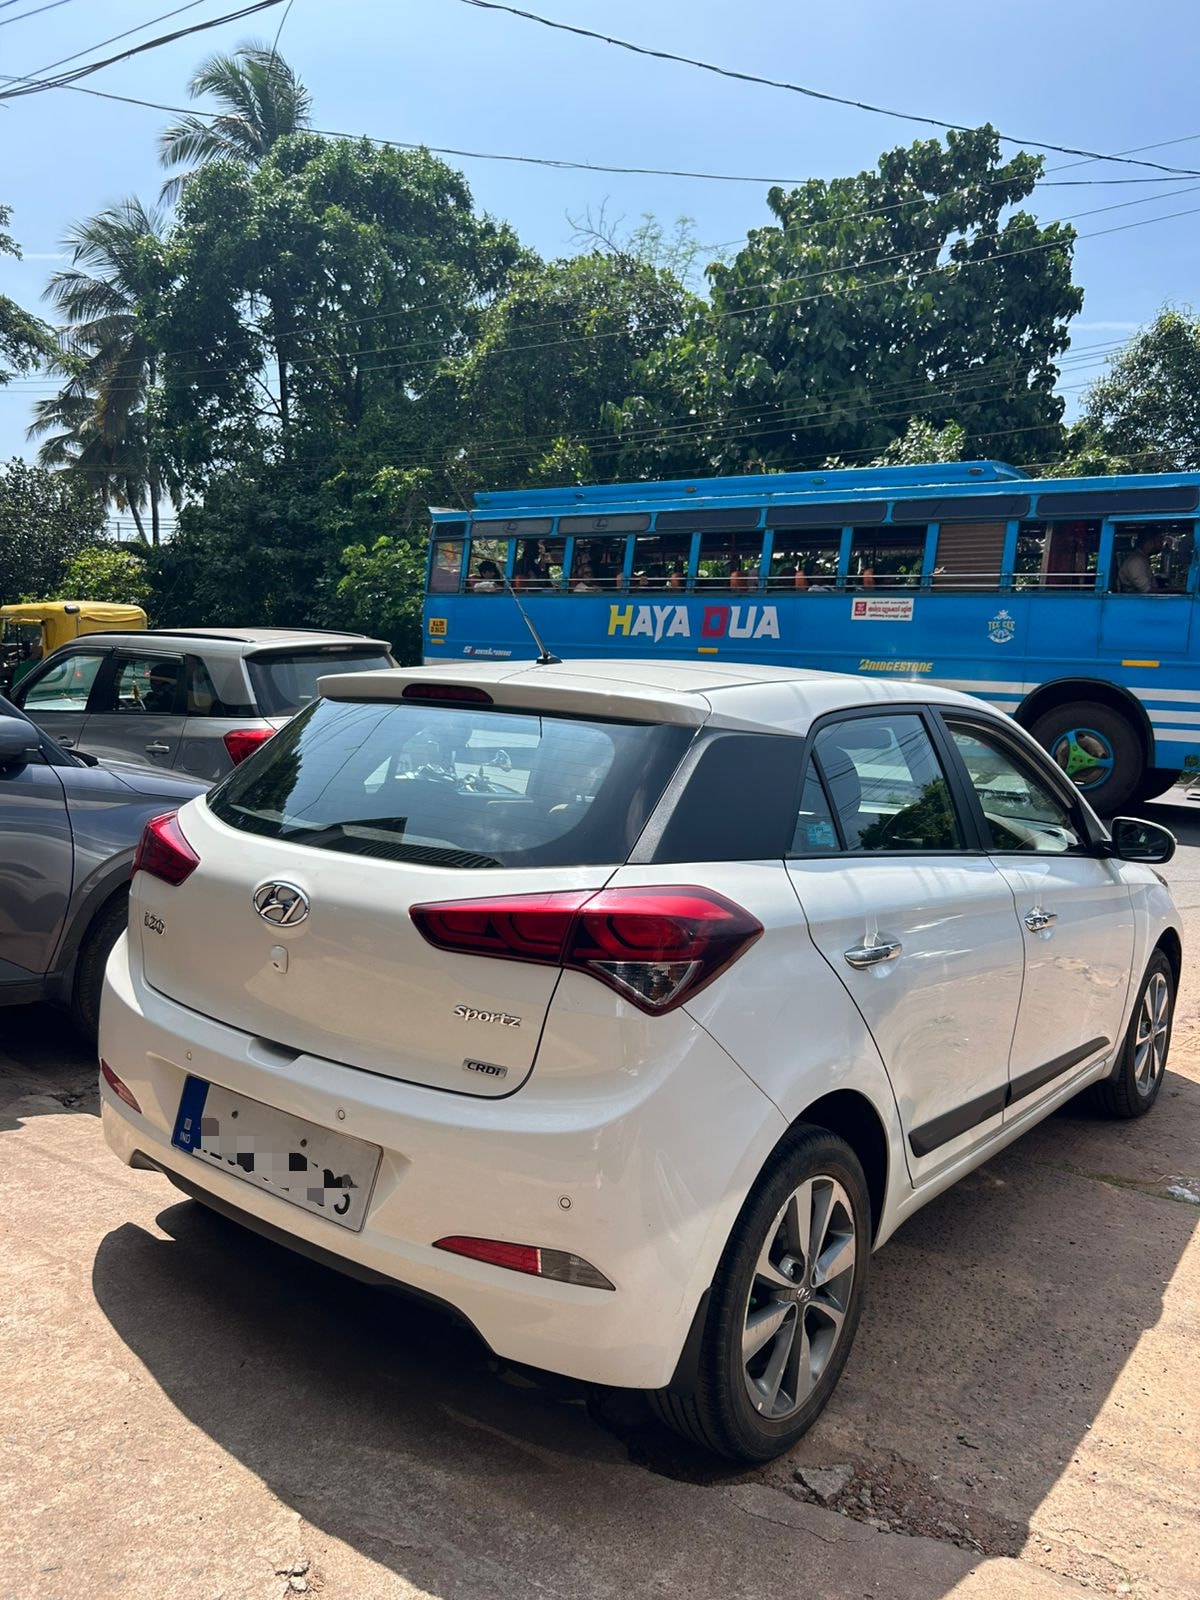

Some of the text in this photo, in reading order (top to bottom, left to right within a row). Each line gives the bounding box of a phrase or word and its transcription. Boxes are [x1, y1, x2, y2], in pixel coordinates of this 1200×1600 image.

[607, 605, 781, 643] HAYA DUA
[858, 659, 934, 673] BRIDGESTONE
[453, 1004, 522, 1028] Sportz
